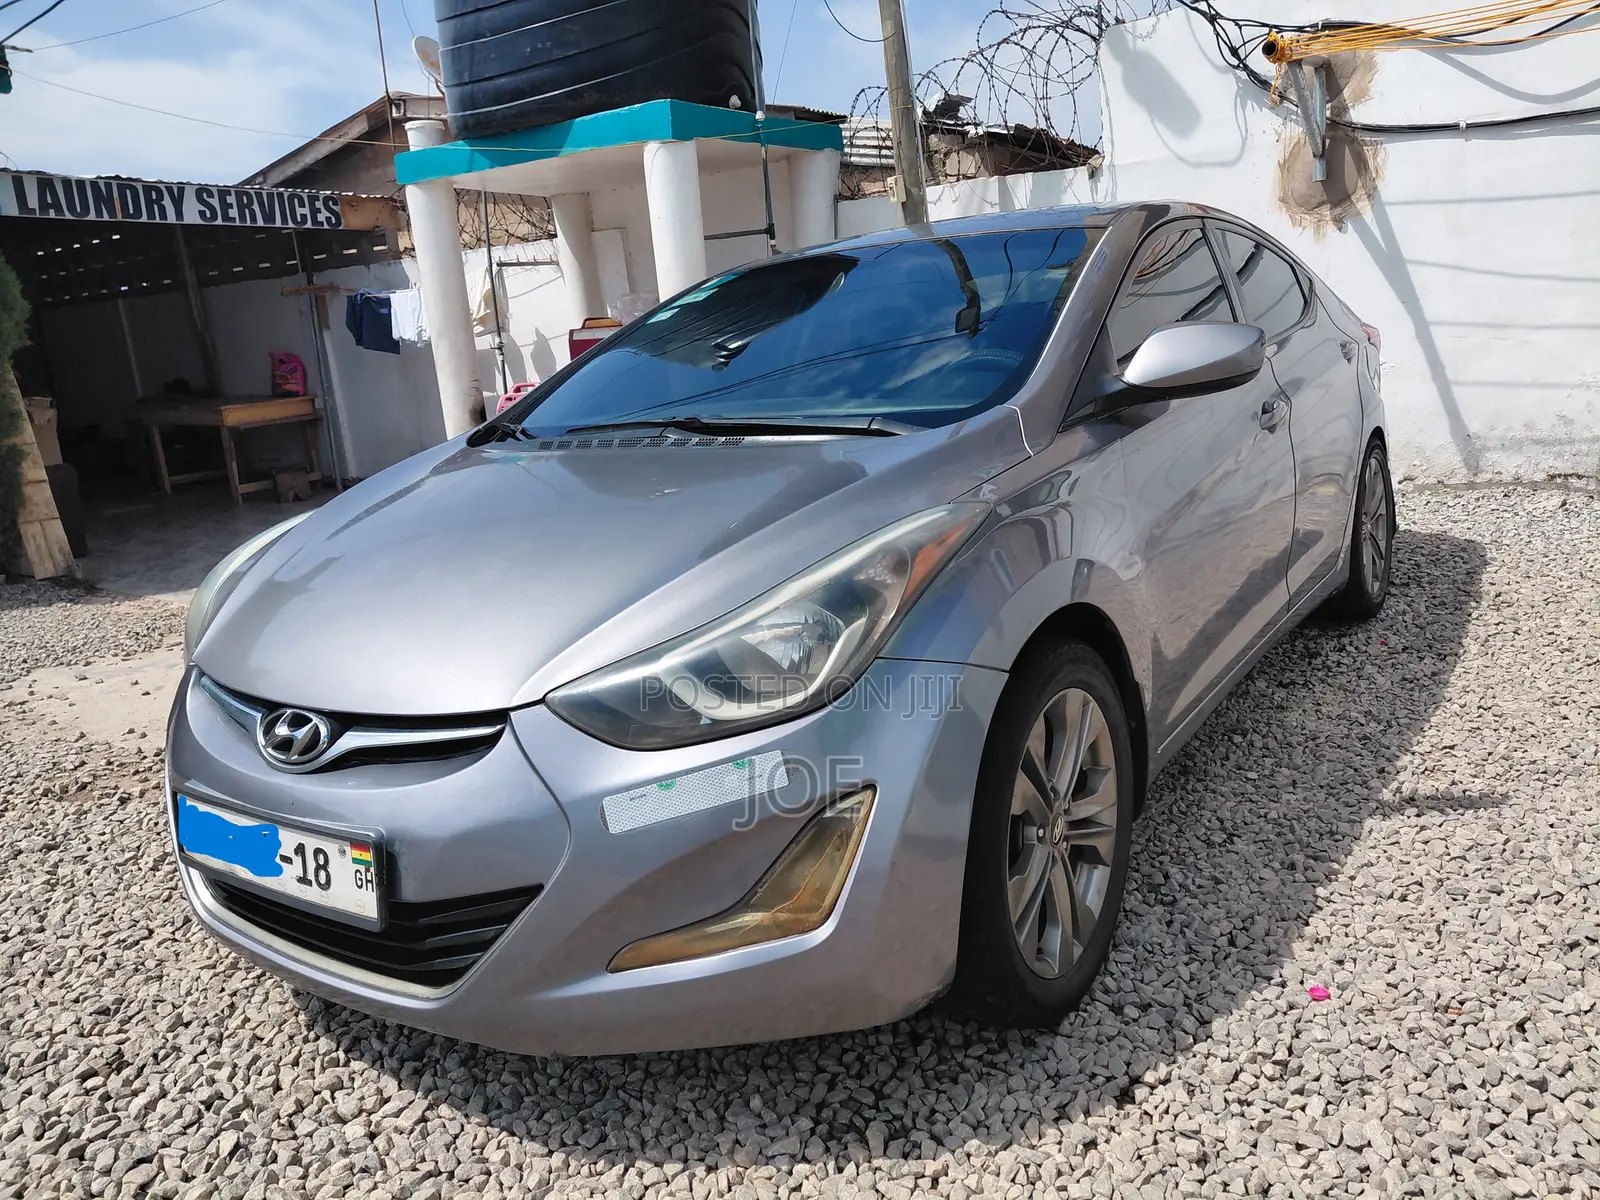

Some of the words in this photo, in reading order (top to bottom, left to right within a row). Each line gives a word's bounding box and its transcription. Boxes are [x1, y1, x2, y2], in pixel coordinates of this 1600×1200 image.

[12, 175, 186, 221] LAUNDRY
[194, 187, 343, 229] SERVICES
[354, 868, 375, 893] GH
